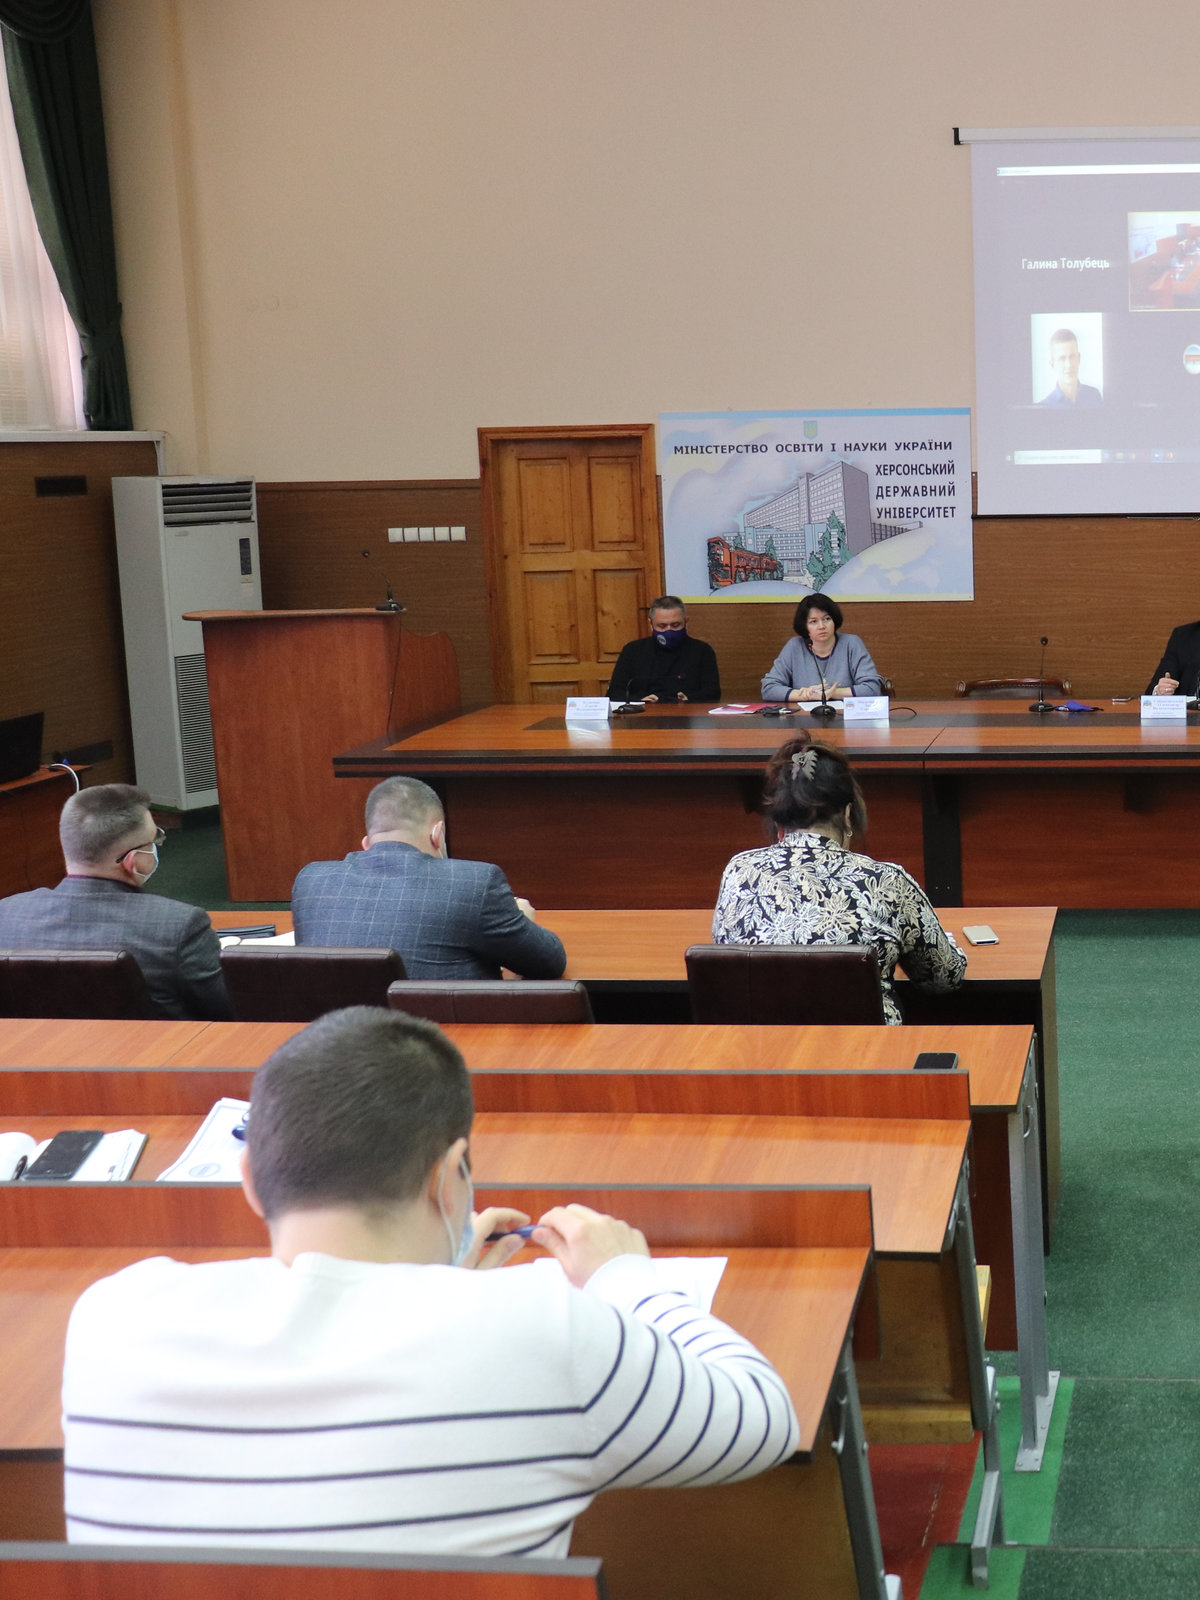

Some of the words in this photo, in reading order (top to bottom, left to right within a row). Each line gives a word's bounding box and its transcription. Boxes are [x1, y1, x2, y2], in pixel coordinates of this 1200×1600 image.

[1021, 258, 1058, 270] Галина
[674, 443, 768, 455] МІНІСТЕРСТВО
[775, 442, 823, 453] ОСВІТИ
[830, 442, 836, 452] І
[844, 442, 887, 452] НАУКИ
[894, 439, 953, 451] УКРАЇНИ
[875, 459, 956, 476] ХЕРСОНСЬКИЙ
[875, 481, 956, 500] ДЕРЖАВНИЙ
[876, 506, 957, 519] УНІВЕРСИТЕТ
